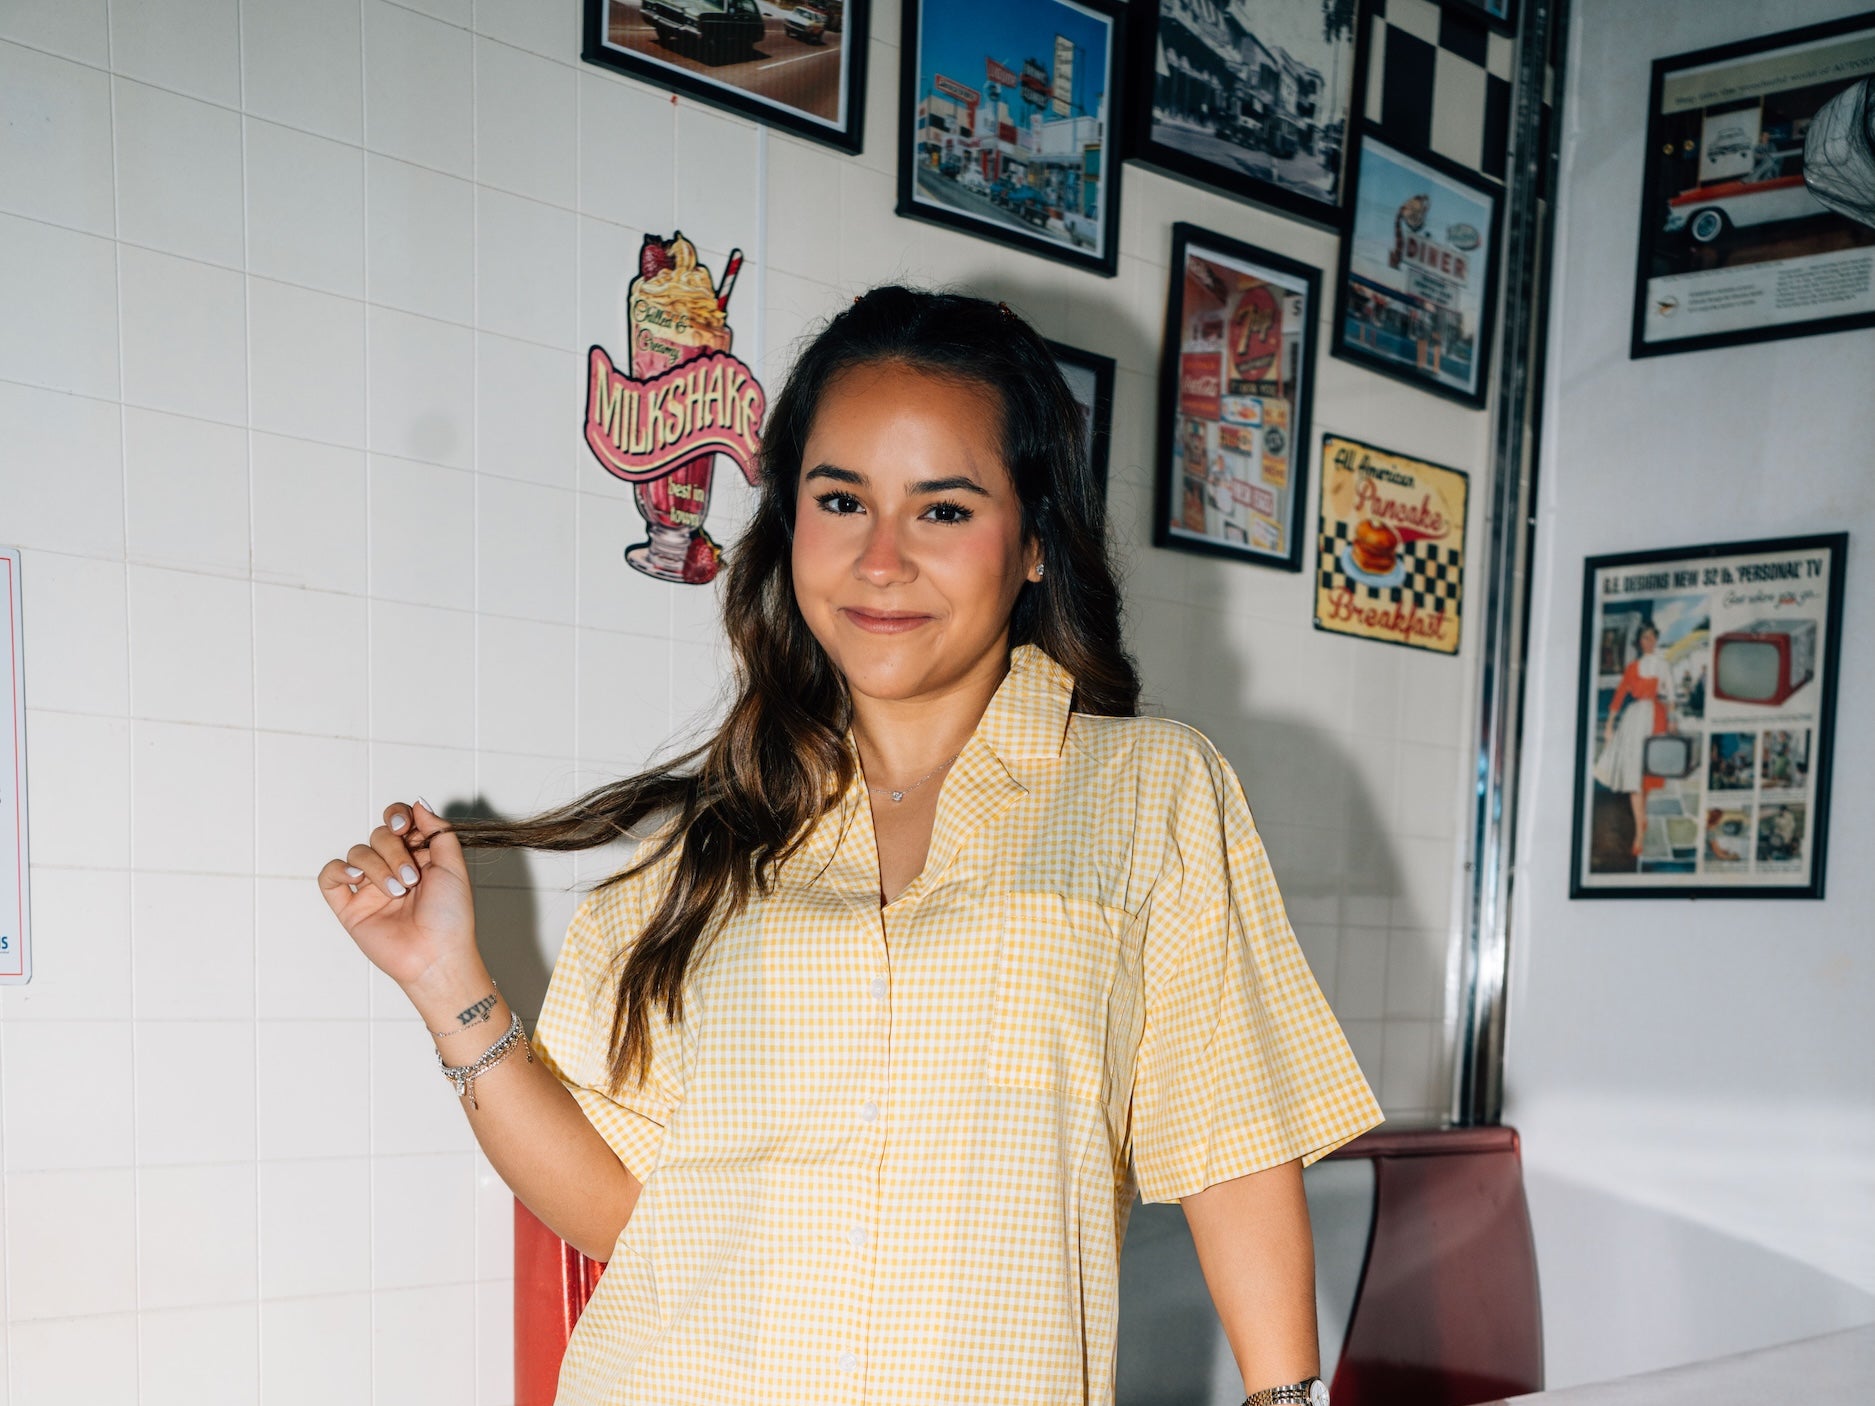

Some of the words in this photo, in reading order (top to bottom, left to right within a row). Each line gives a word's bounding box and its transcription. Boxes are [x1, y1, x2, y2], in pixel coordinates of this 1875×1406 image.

[1406, 236, 1466, 280] DINER
[636, 328, 681, 365] Creamy
[1334, 447, 1355, 472] All
[1358, 455, 1415, 488] American
[668, 473, 692, 500] best
[694, 483, 705, 503] in
[1355, 477, 1444, 533] Pancake
[670, 507, 699, 527] town
[1673, 569, 1698, 588] NEW
[1703, 567, 1719, 586] 32
[1806, 558, 1823, 577] TV
[1328, 585, 1447, 643] Breakfast
